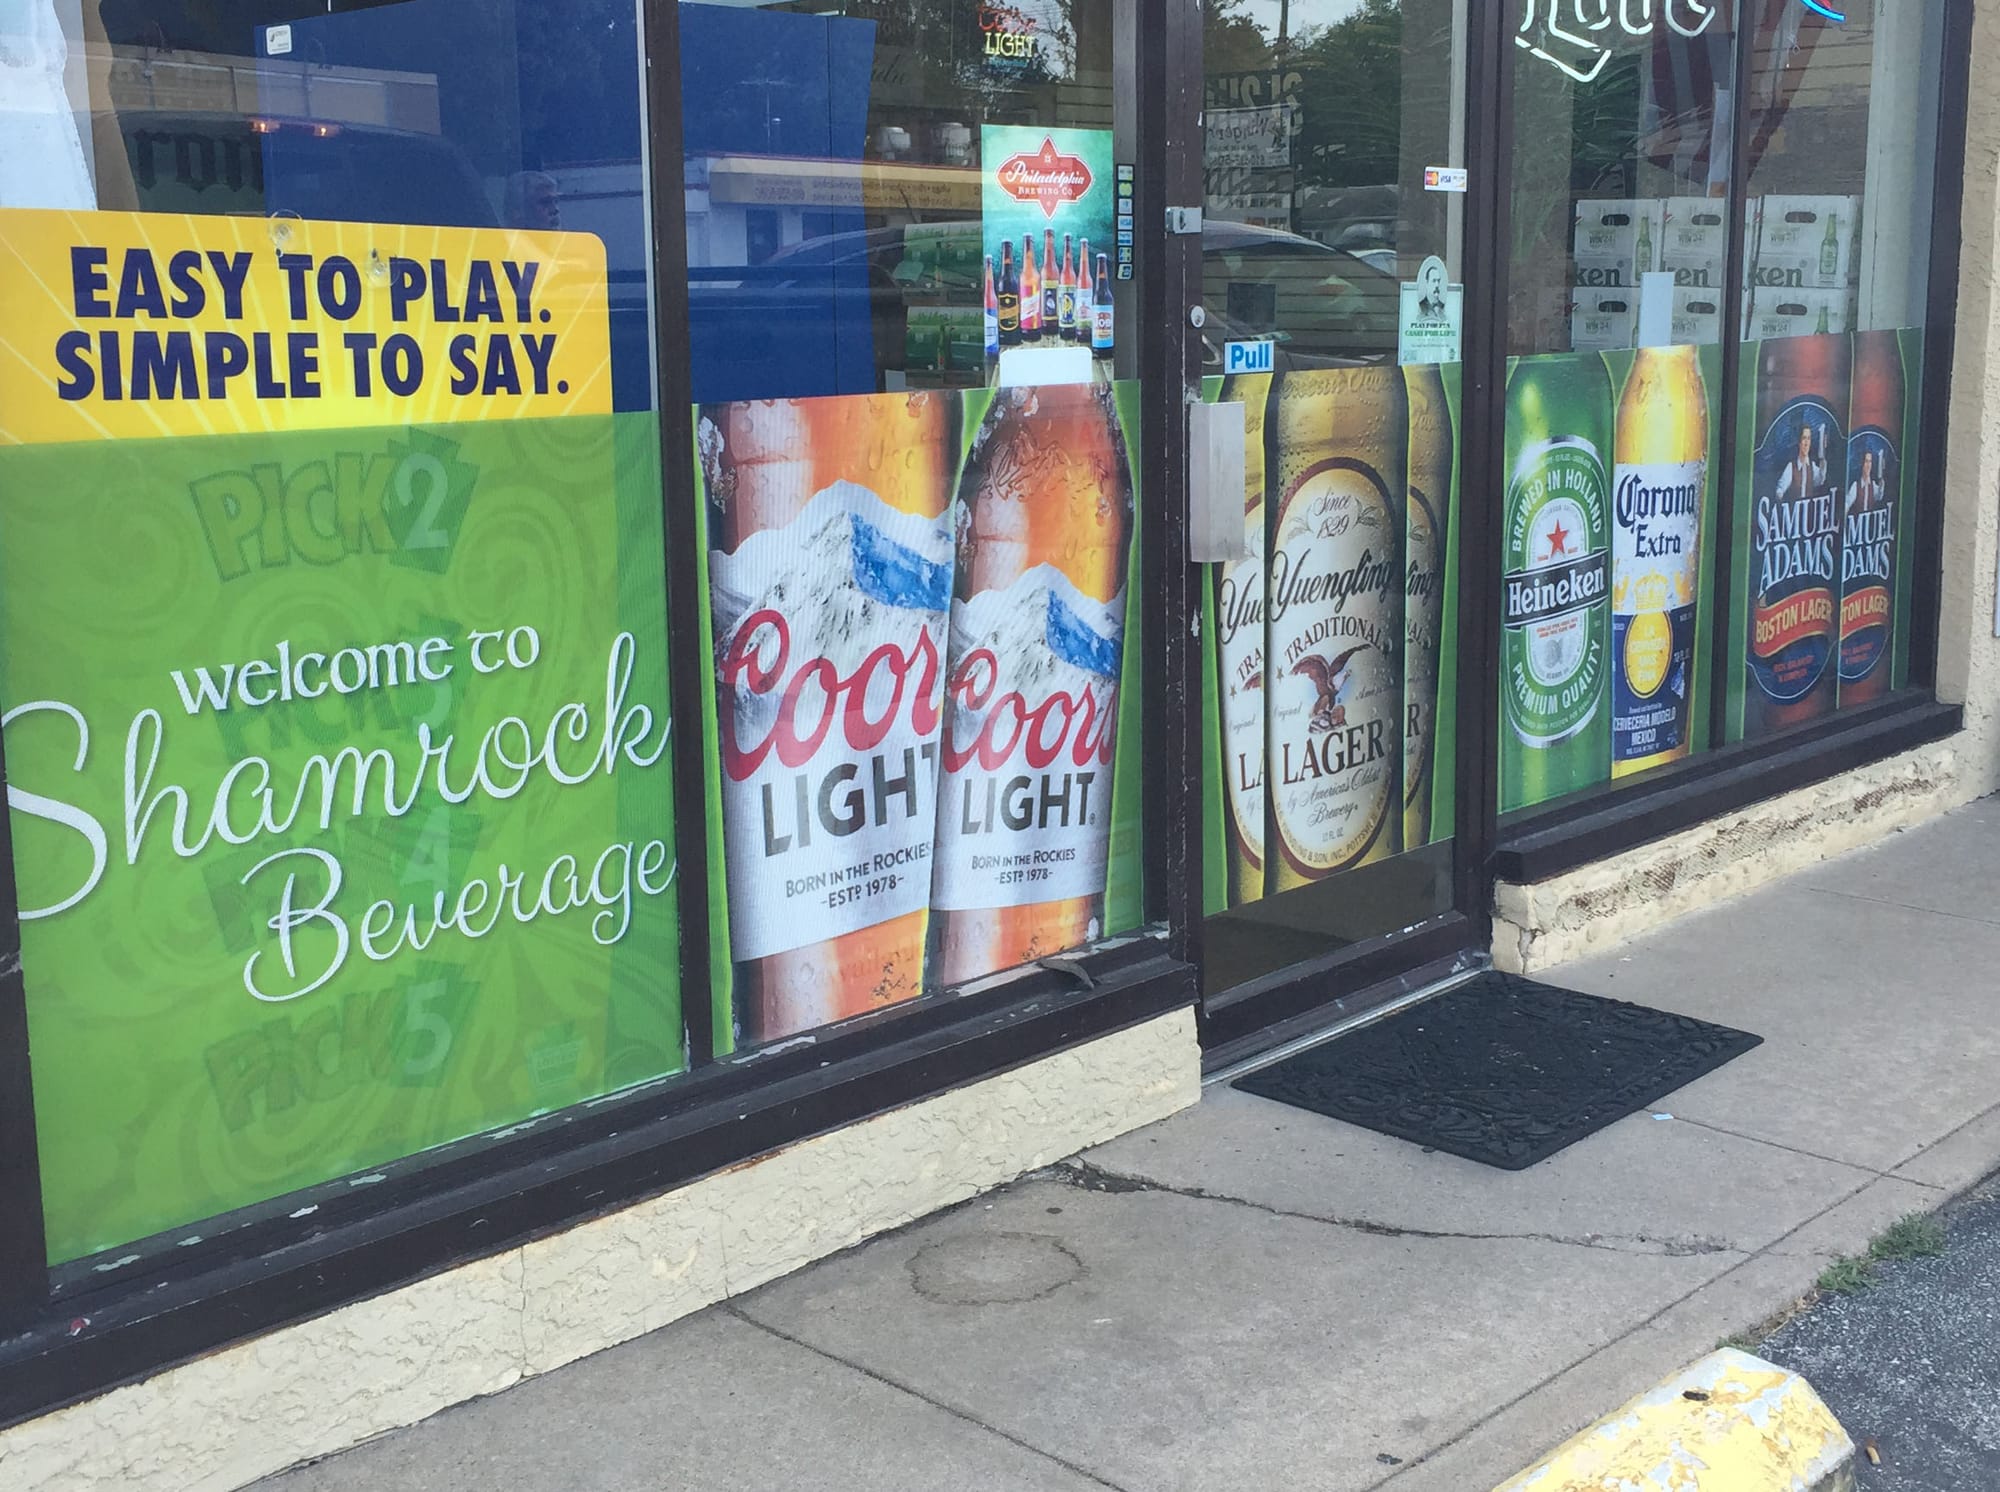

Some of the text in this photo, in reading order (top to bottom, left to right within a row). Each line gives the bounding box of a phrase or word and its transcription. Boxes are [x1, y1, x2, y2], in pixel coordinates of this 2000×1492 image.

[984, 32, 1035, 57] LIGHT
[1006, 160, 1084, 187] Philadelphia
[1018, 187, 1058, 195] BREWING
[70, 246, 551, 324] EASY TO PLAY.
[56, 331, 569, 402] SIMPLE TO SAY.
[1231, 345, 1269, 369] Pull
[188, 452, 448, 583] PICK 2
[1313, 486, 1351, 516] Since
[1317, 514, 1350, 539] 1829
[1512, 468, 1602, 552] BREWED IN HOLLAND
[1616, 473, 1696, 534] Corona
[1756, 487, 1839, 551] SAMUEL
[1635, 524, 1682, 558] Extra
[1758, 534, 1835, 599] ADAMS
[1270, 548, 1392, 622] Yuengling
[1508, 566, 1605, 616] Heineken
[1863, 595, 1888, 616] LAGER
[1285, 616, 1382, 664] TRADITIONAL
[1756, 599, 1832, 643] BOSTON LAGER
[169, 625, 541, 715] welcome to
[1512, 640, 1601, 715] PREMIUM QUALITY
[943, 649, 1118, 773] Coors
[1, 631, 672, 920] Shamrock
[1283, 719, 1385, 785] LAGER
[961, 772, 1095, 835] LIGHT
[786, 873, 827, 898] BORN
[830, 871, 844, 886] IN
[846, 862, 870, 880] THE
[972, 848, 1076, 870] BORN IN THE ROCKIES
[242, 839, 676, 1002] Beverage
[405, 978, 453, 1076] 5
